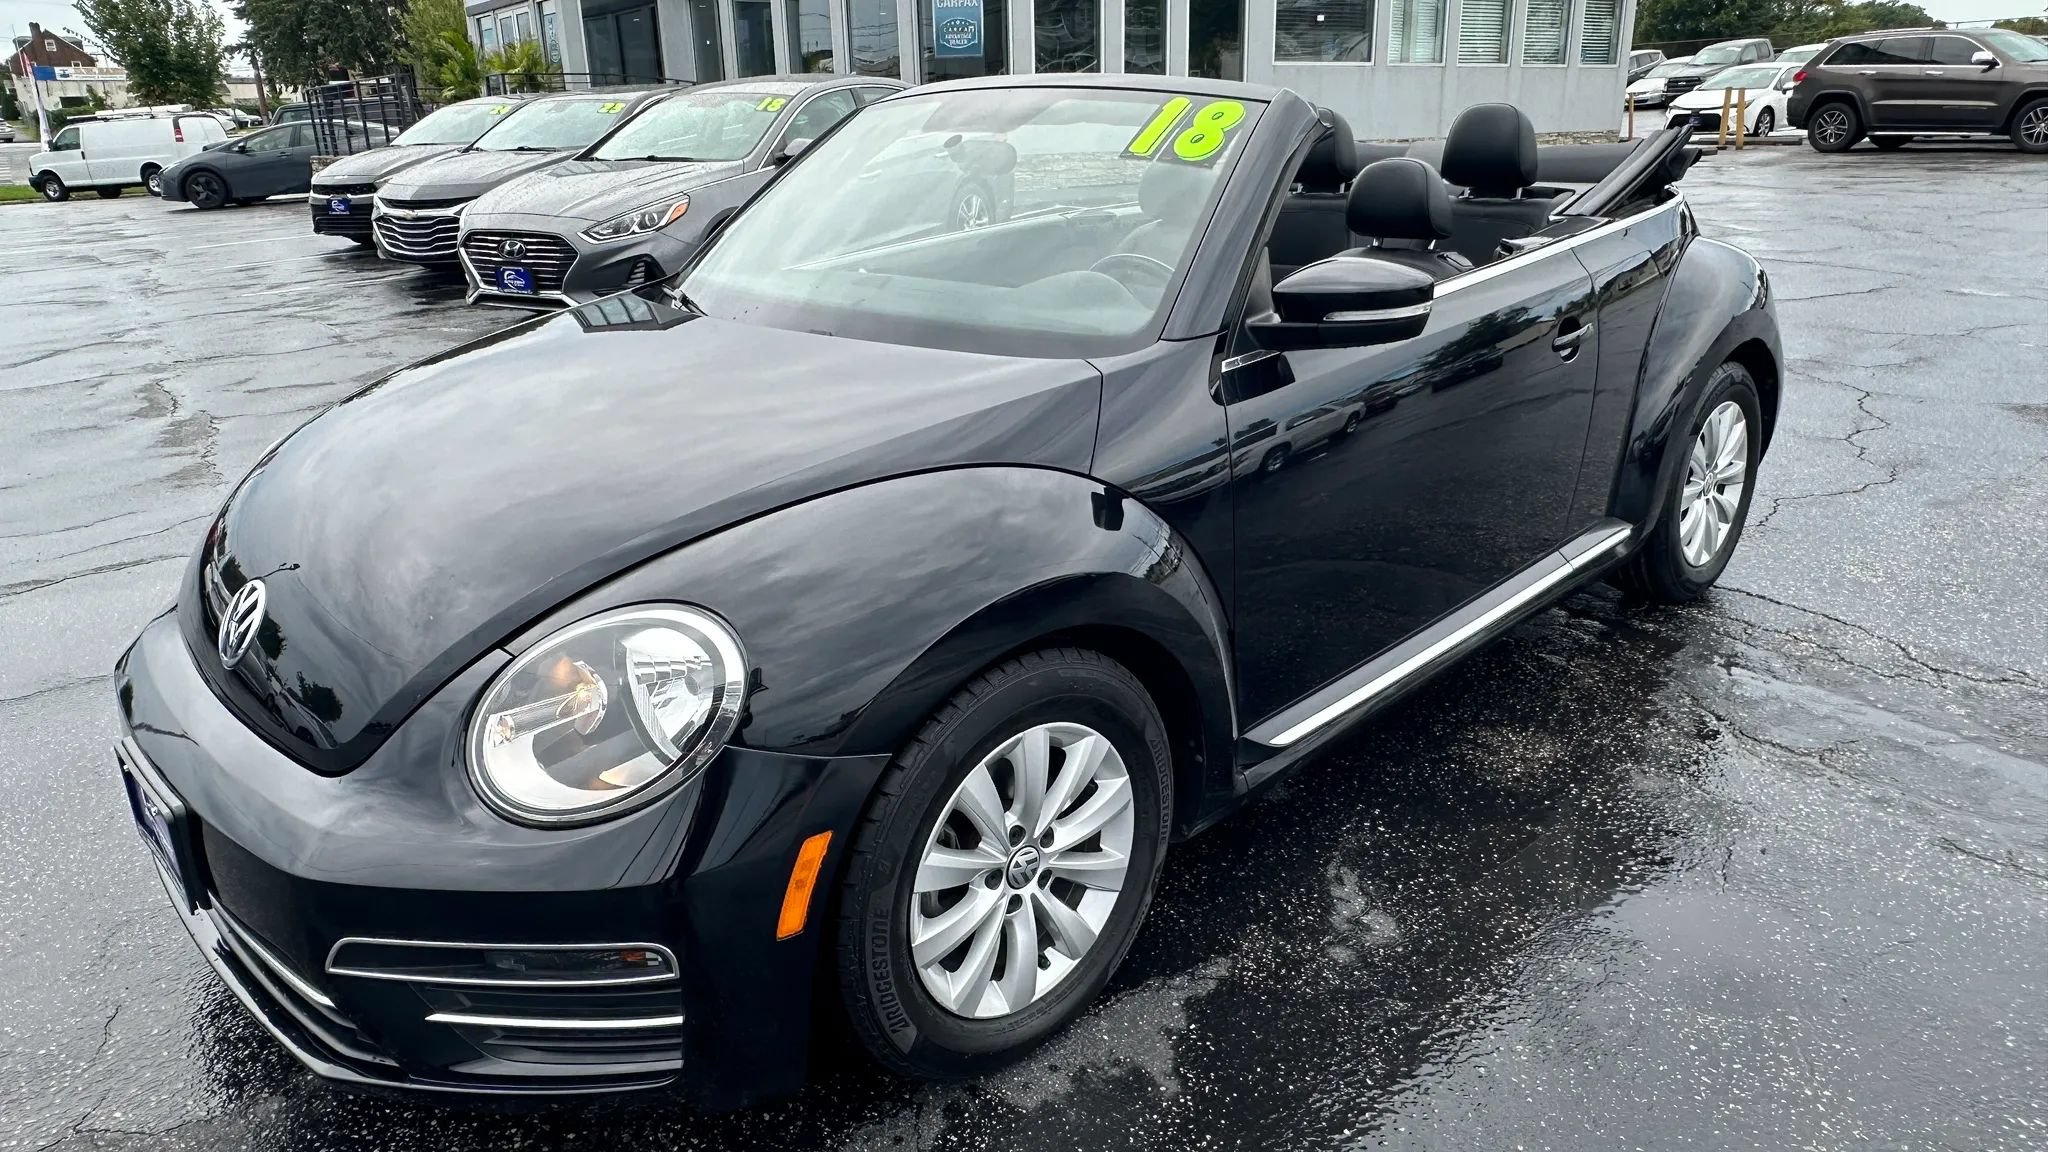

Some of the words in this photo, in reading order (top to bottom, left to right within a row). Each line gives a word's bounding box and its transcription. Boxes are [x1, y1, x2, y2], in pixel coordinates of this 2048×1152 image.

[936, 0, 978, 8] CARFAX
[755, 96, 786, 112] 18
[1127, 96, 1247, 161] 18
[871, 908, 912, 1035] BRIDGESTONE
